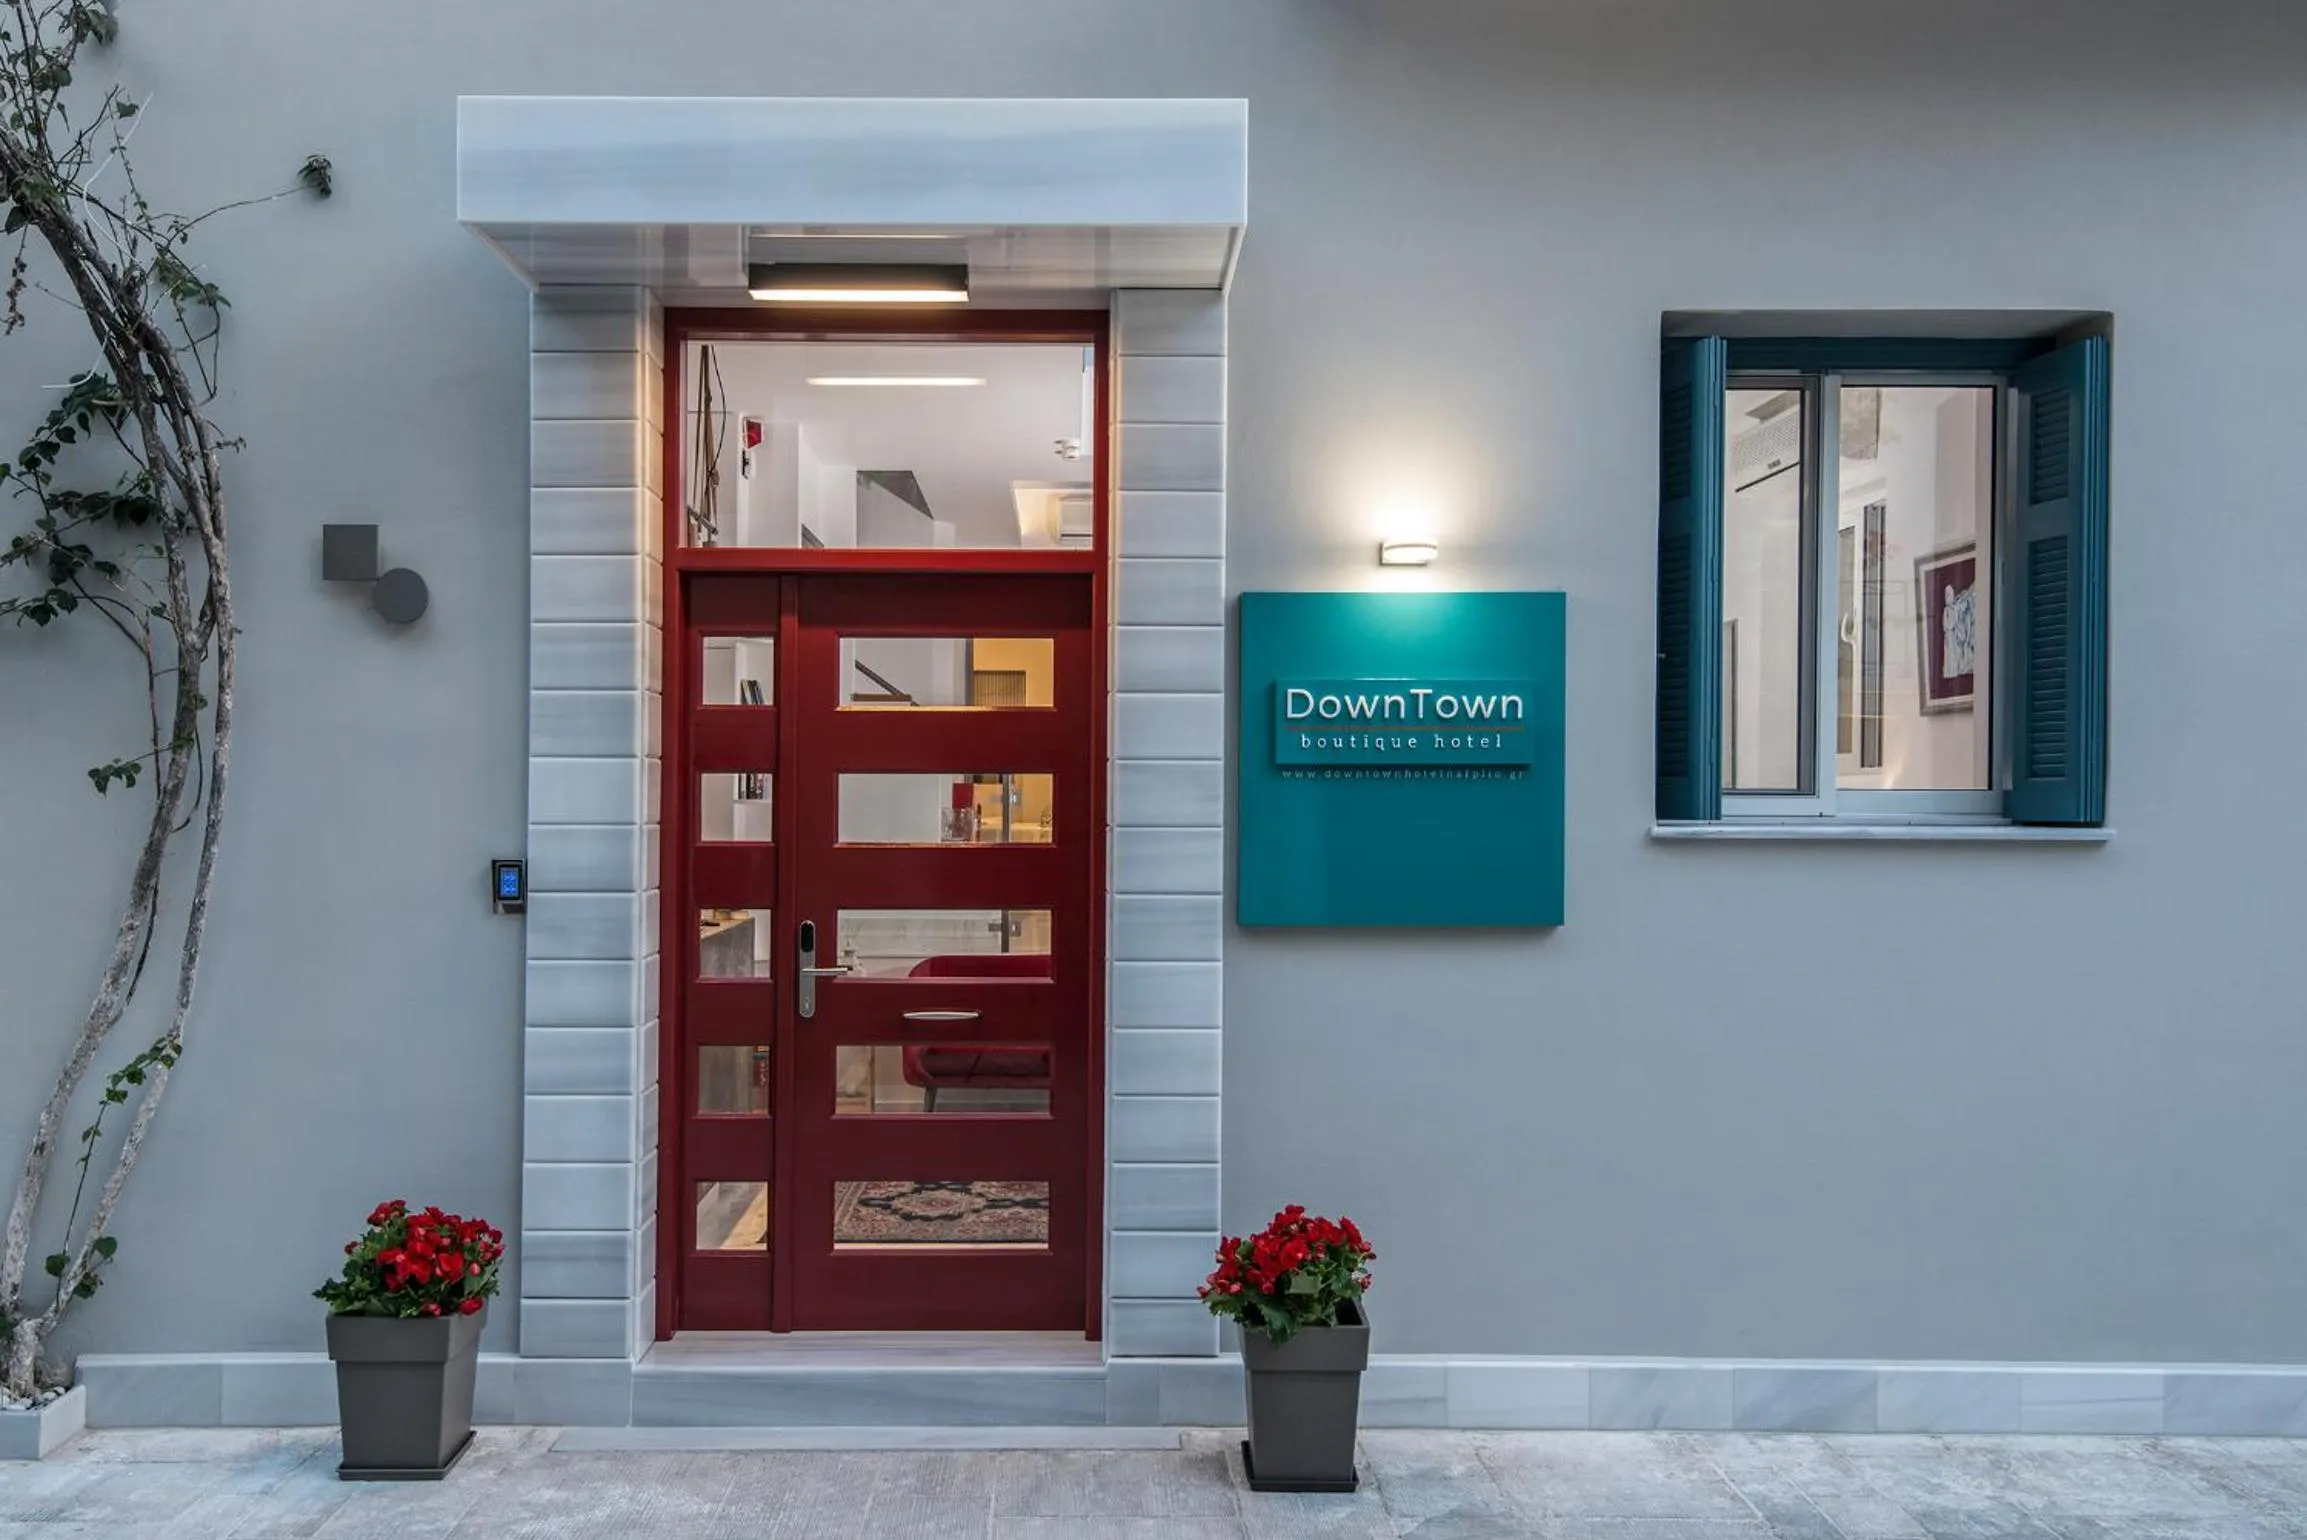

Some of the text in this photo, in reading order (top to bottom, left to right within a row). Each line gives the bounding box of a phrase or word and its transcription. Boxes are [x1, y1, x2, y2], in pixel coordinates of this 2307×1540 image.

[1286, 688, 1523, 719] DownTown
[1301, 733, 1502, 750] boutique hotel
